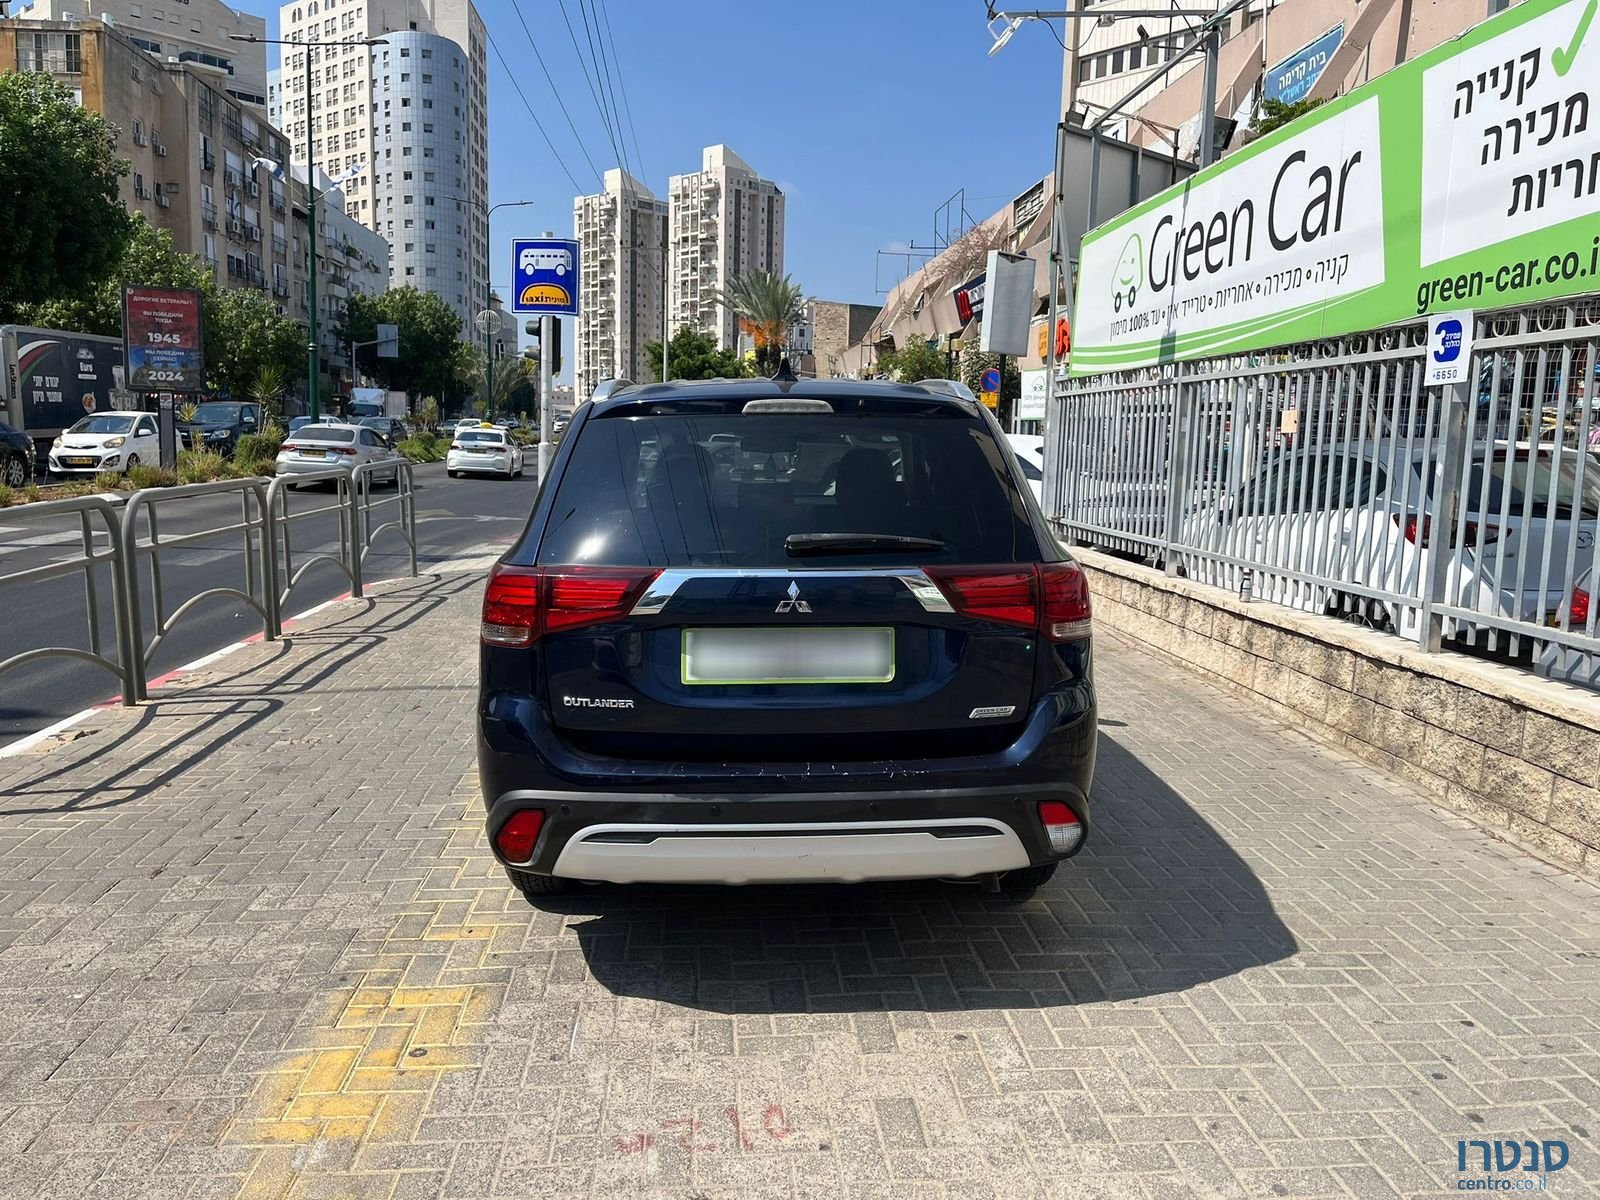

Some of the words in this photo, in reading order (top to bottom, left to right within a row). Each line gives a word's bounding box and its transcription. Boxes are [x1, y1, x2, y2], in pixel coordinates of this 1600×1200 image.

[1308, 51, 1326, 71] בית
[1278, 61, 1306, 90] קדימה
[1453, 47, 1541, 119] קנייה
[1481, 91, 1589, 166] מכירה
[1148, 199, 1254, 293] Green
[1267, 149, 1363, 251] Car
[1263, 267, 1302, 296] מכירה
[1314, 253, 1349, 285] קניה
[1416, 236, 1600, 315] green-car.co.i
[1182, 295, 1206, 317] טרייד
[1214, 281, 1254, 309] אחריות
[1129, 312, 1149, 332] 100%
[1151, 309, 1160, 326] עד
[147, 332, 180, 343] 1945
[79, 362, 93, 372] Euro
[148, 370, 185, 381] 2024
[563, 696, 635, 708] OUTLANDER
